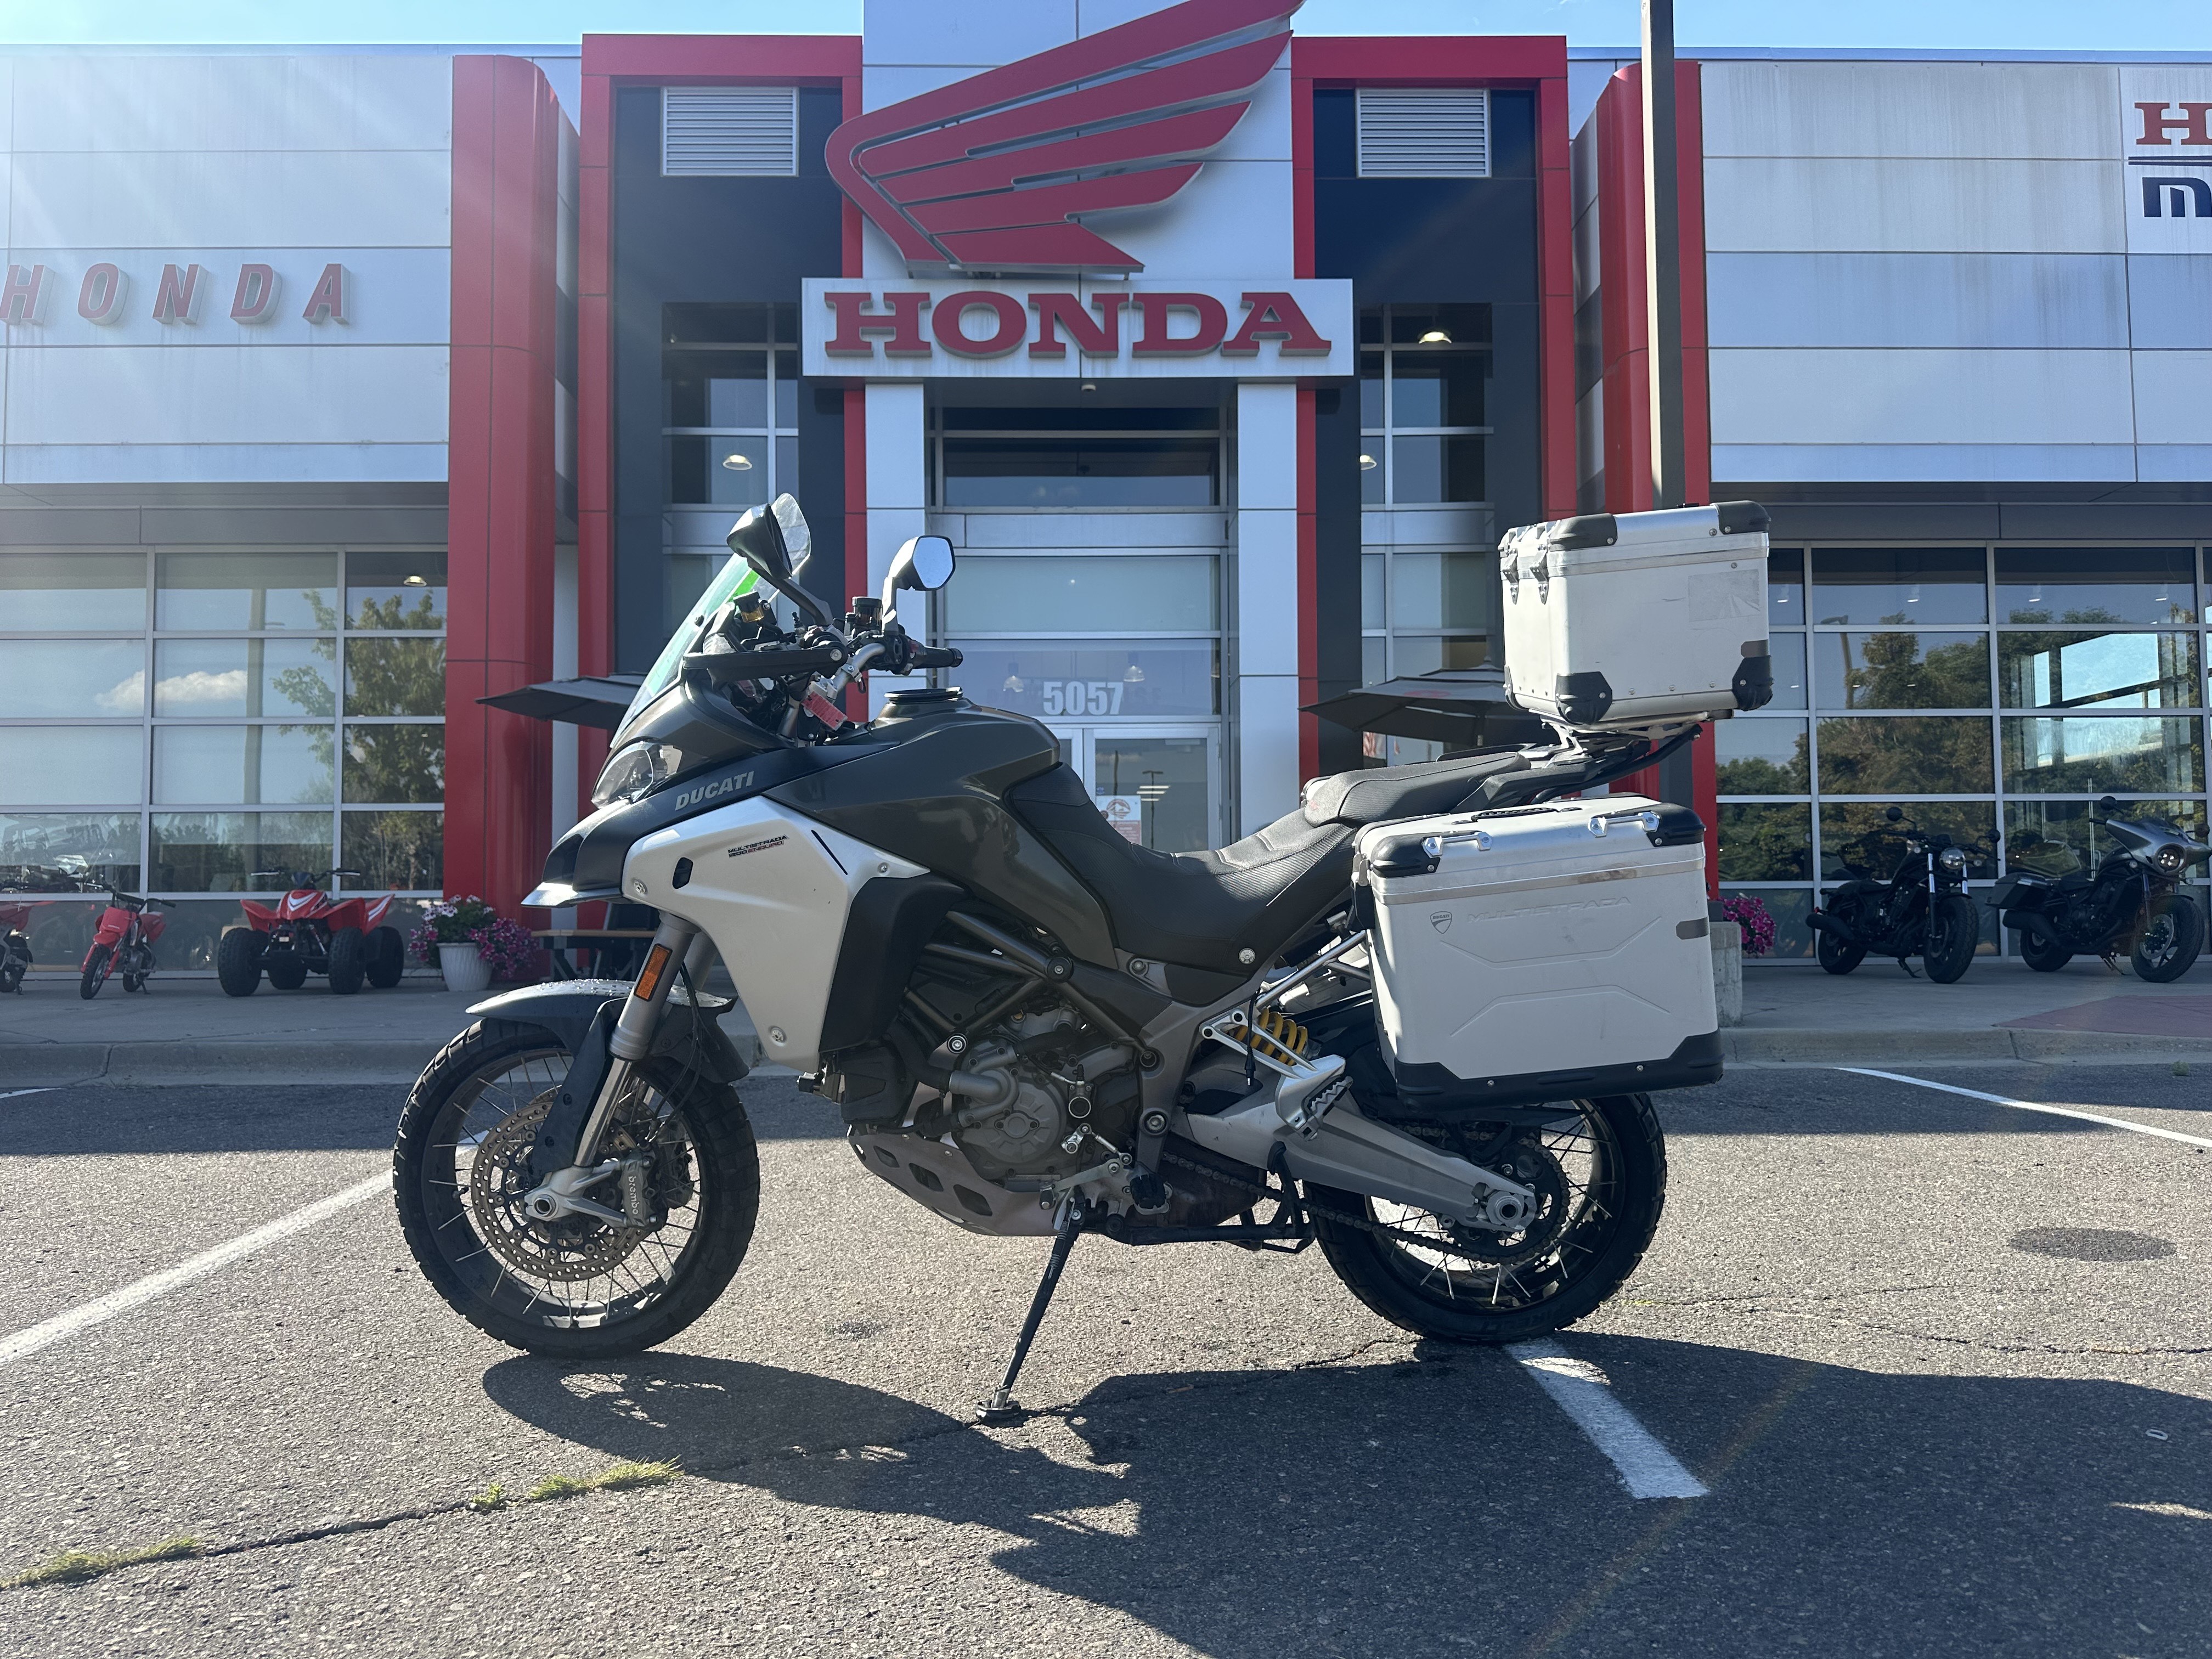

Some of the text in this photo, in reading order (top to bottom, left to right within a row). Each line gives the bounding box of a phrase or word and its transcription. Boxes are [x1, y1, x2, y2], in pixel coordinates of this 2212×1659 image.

[0, 263, 351, 325] HONDA
[823, 291, 1331, 359] HONDA
[1043, 681, 1124, 716] 5057
[675, 770, 754, 811] DUCATI
[727, 834, 789, 854] MULTISTRADA
[747, 840, 785, 854] ENDURO
[628, 1176, 640, 1215] brembo
